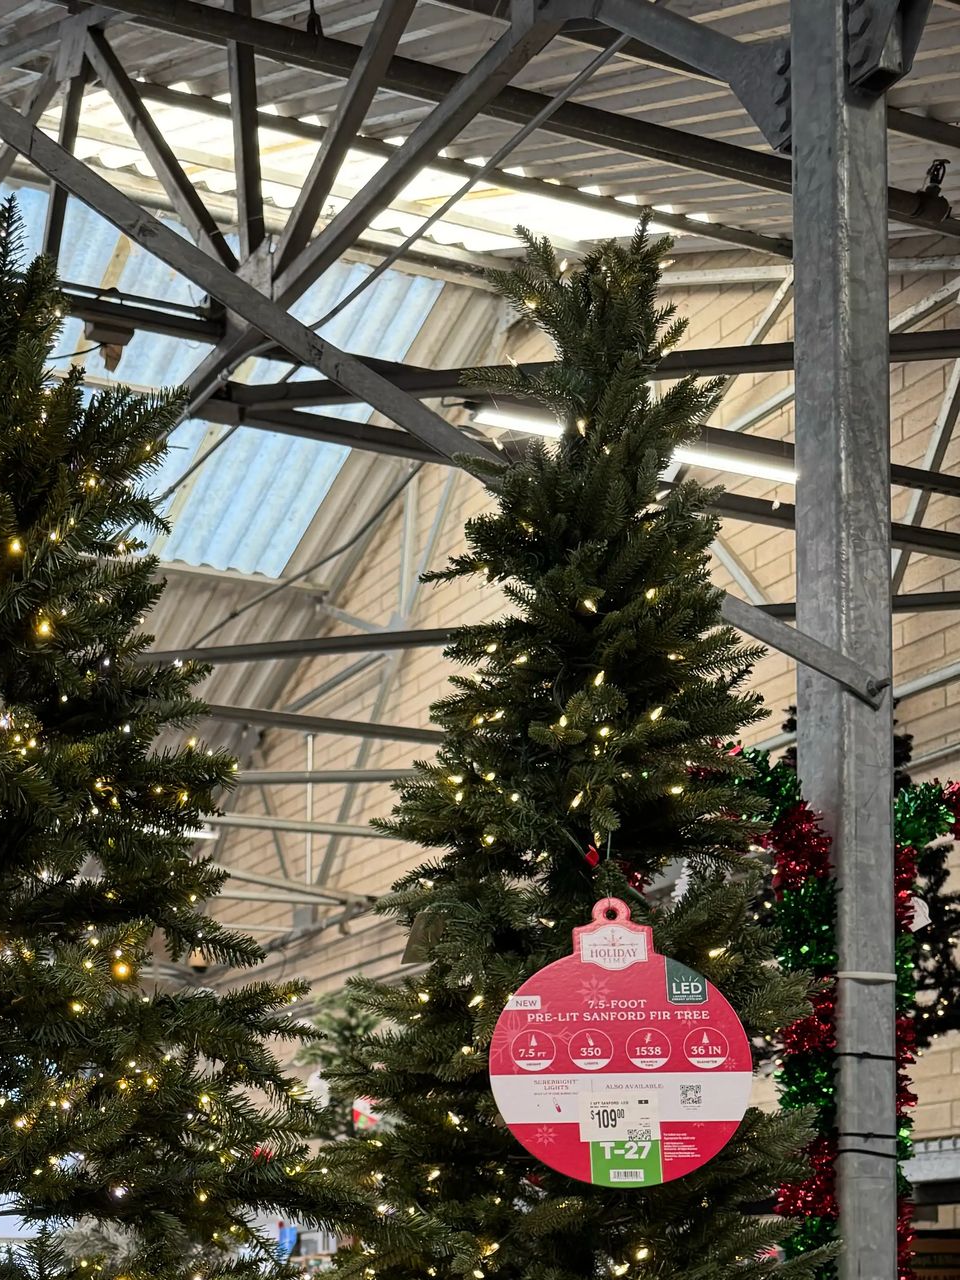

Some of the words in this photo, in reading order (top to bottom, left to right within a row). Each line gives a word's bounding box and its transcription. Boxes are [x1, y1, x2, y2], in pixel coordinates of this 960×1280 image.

[590, 948, 637, 958] HOLIDAY
[672, 982, 702, 994] LED
[515, 999, 538, 1007] NEW
[588, 999, 647, 1009] 7.5-FOOT
[527, 1012, 580, 1022] PRE-LIT
[583, 1011, 646, 1021] SANFORD
[649, 1010, 671, 1020] FIR
[674, 1010, 710, 1020] TREE
[518, 1048, 535, 1058] 7.5
[580, 1047, 602, 1057] 350
[635, 1046, 662, 1056] 1538
[691, 1046, 705, 1055] 36
[708, 1045, 722, 1055] IN
[599, 1141, 652, 1159] T-27
